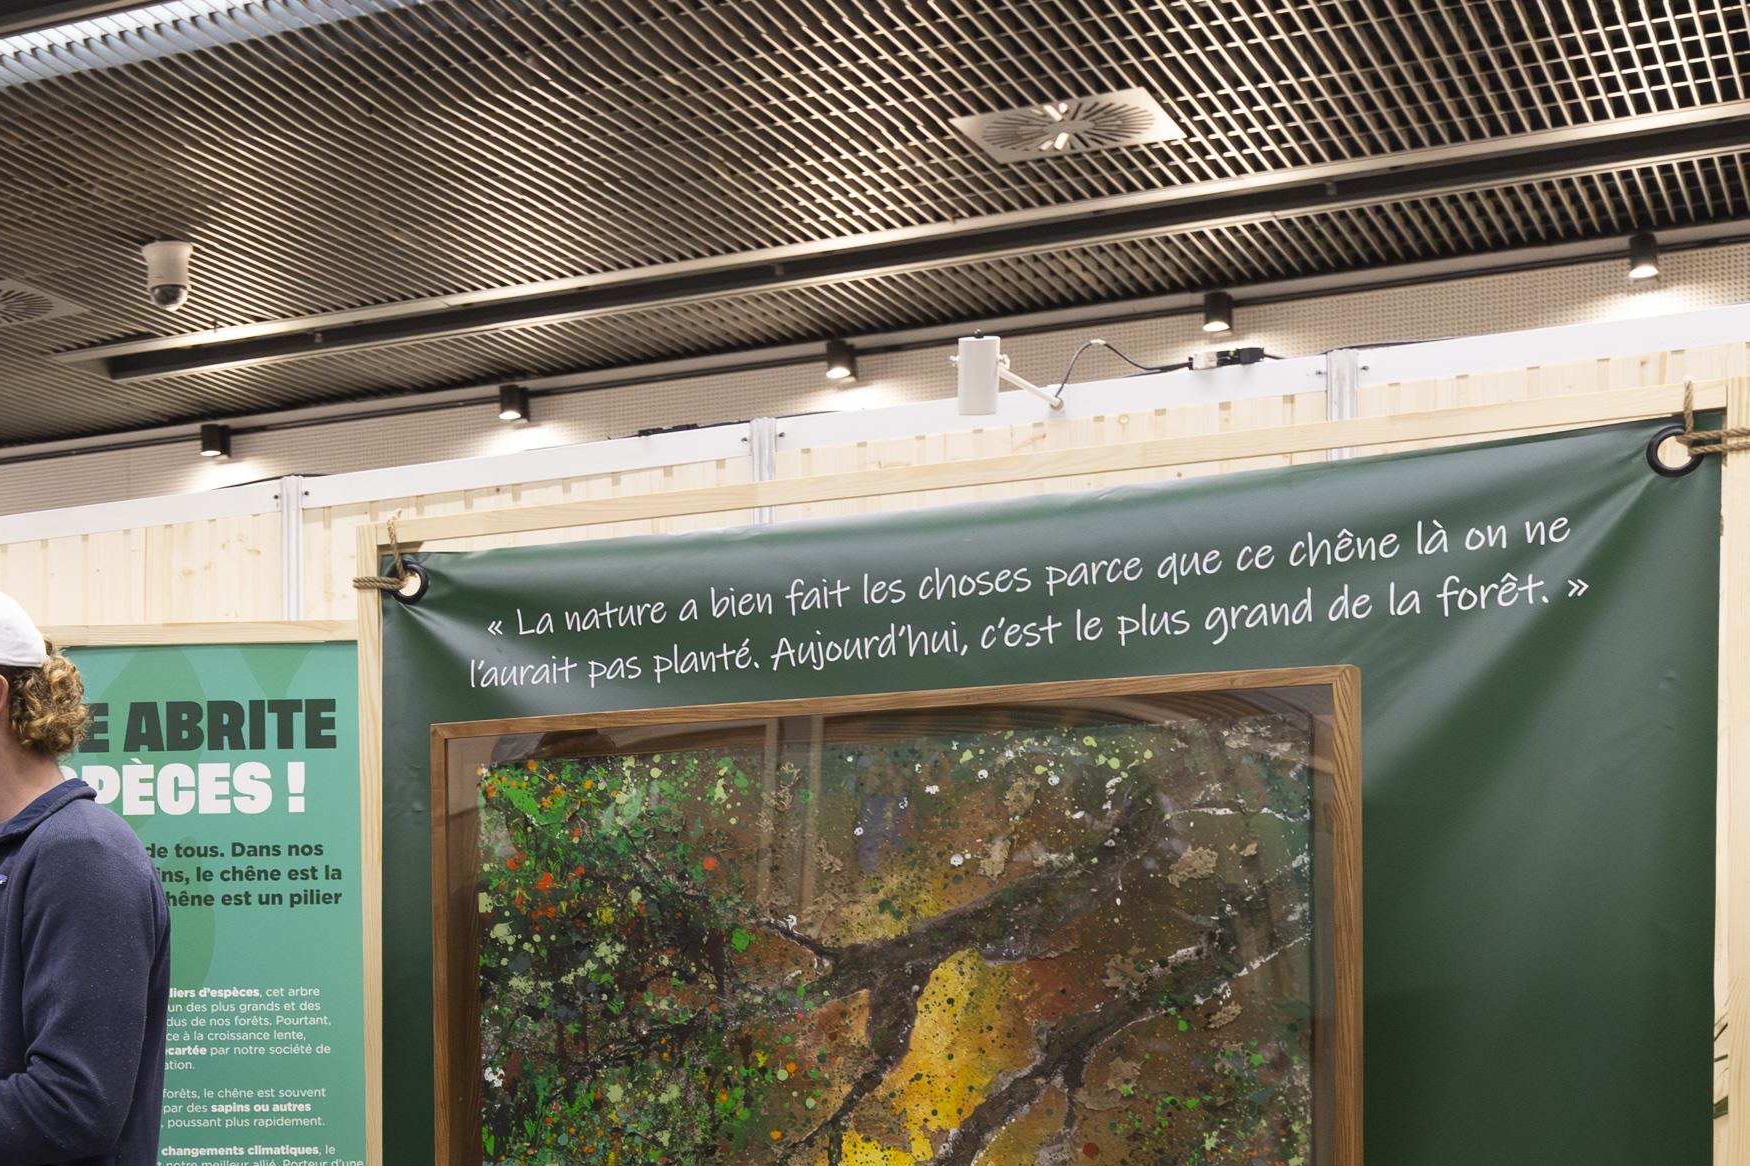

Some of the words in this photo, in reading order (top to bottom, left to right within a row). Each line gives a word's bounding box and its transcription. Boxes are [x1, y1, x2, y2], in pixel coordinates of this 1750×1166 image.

[517, 608, 554, 635] La
[565, 601, 667, 632] nature
[679, 599, 698, 621] a
[710, 587, 772, 618] bien
[785, 578, 850, 616] fait
[863, 573, 906, 604] les
[918, 567, 1032, 600] choses
[1045, 557, 1143, 596] parce
[1157, 550, 1222, 585] que
[1236, 545, 1275, 571] ce
[1289, 528, 1400, 567] chêne
[1417, 519, 1449, 555] là
[1465, 524, 1507, 551] on
[1525, 517, 1571, 545] ne
[465, 648, 578, 688] l'aurait
[588, 656, 642, 686] pas
[653, 638, 759, 681] planté.
[1076, 609, 1103, 641] le
[1117, 603, 1190, 646] plus
[1205, 587, 1312, 645] grand
[1328, 584, 1372, 622] de
[1389, 581, 1421, 616] la
[1436, 572, 1549, 617] forêt.
[123, 698, 337, 752] ABRITE
[60, 758, 273, 816] PÈCES
[288, 761, 305, 813] !
[174, 843, 224, 858] tous.
[231, 843, 281, 857] Dans
[288, 844, 324, 856] nos
[196, 866, 214, 882] le
[220, 866, 281, 882] chêne
[288, 866, 318, 881] est
[325, 865, 342, 880] la
[169, 891, 215, 907] hêne
[221, 891, 252, 906] est
[258, 893, 283, 906] un
[290, 890, 342, 908] pilier
[198, 988, 262, 999] d'espèces,
[266, 987, 284, 997] cet
[288, 987, 320, 997] arbre
[186, 1003, 207, 1012] des
[211, 1003, 236, 1013] plus
[238, 1002, 280, 1013] grands
[283, 1002, 296, 1011] et
[299, 1002, 321, 1011] des
[190, 1017, 206, 1026] de
[209, 1018, 231, 1026] nos
[234, 1016, 272, 1026] forêts.
[276, 1015, 331, 1026] Pourtant,
[183, 1031, 190, 1041] à
[194, 1031, 204, 1041] la
[207, 1031, 270, 1041] croissance
[274, 1030, 306, 1041] lente,
[210, 1047, 230, 1056] par
[234, 1045, 266, 1055] notre
[269, 1044, 312, 1054] société
[315, 1044, 331, 1054] de
[204, 1089, 214, 1098] le
[217, 1089, 254, 1098] chêne
[257, 1088, 275, 1098] est
[278, 1088, 326, 1098] souvent
[163, 1105, 183, 1114] par
[186, 1104, 208, 1113] des
[211, 1103, 250, 1114] sapins
[253, 1104, 269, 1112] ou
[272, 1103, 311, 1112] autres
[167, 1117, 221, 1129] poussant
[225, 1117, 250, 1128] plus
[253, 1116, 325, 1128] rapidement.
[161, 1146, 245, 1158] changements
[247, 1145, 321, 1157] climatiques,
[325, 1145, 335, 1155] le
